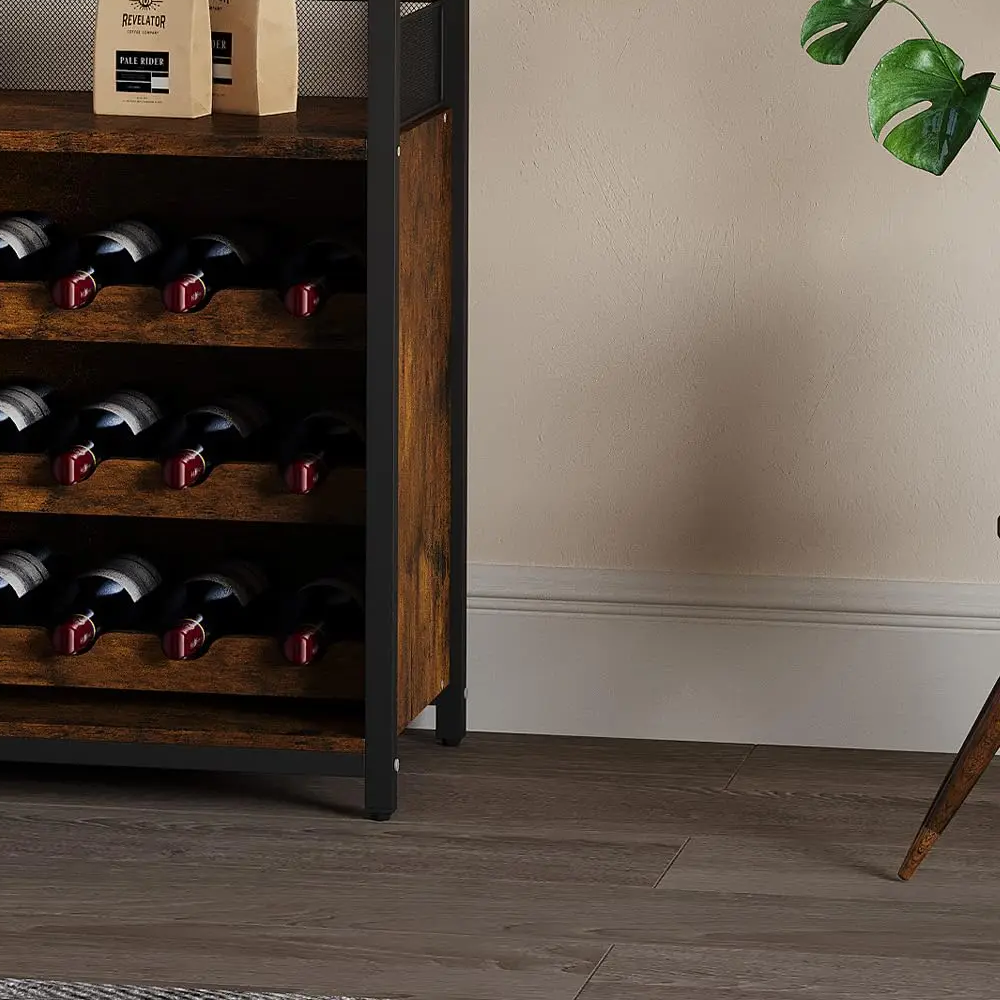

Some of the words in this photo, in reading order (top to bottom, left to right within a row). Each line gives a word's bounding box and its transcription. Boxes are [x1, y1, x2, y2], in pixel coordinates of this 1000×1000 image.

[122, 13, 166, 29] REVELATOR
[119, 56, 139, 65] PALE
[140, 56, 164, 66] RIDER
